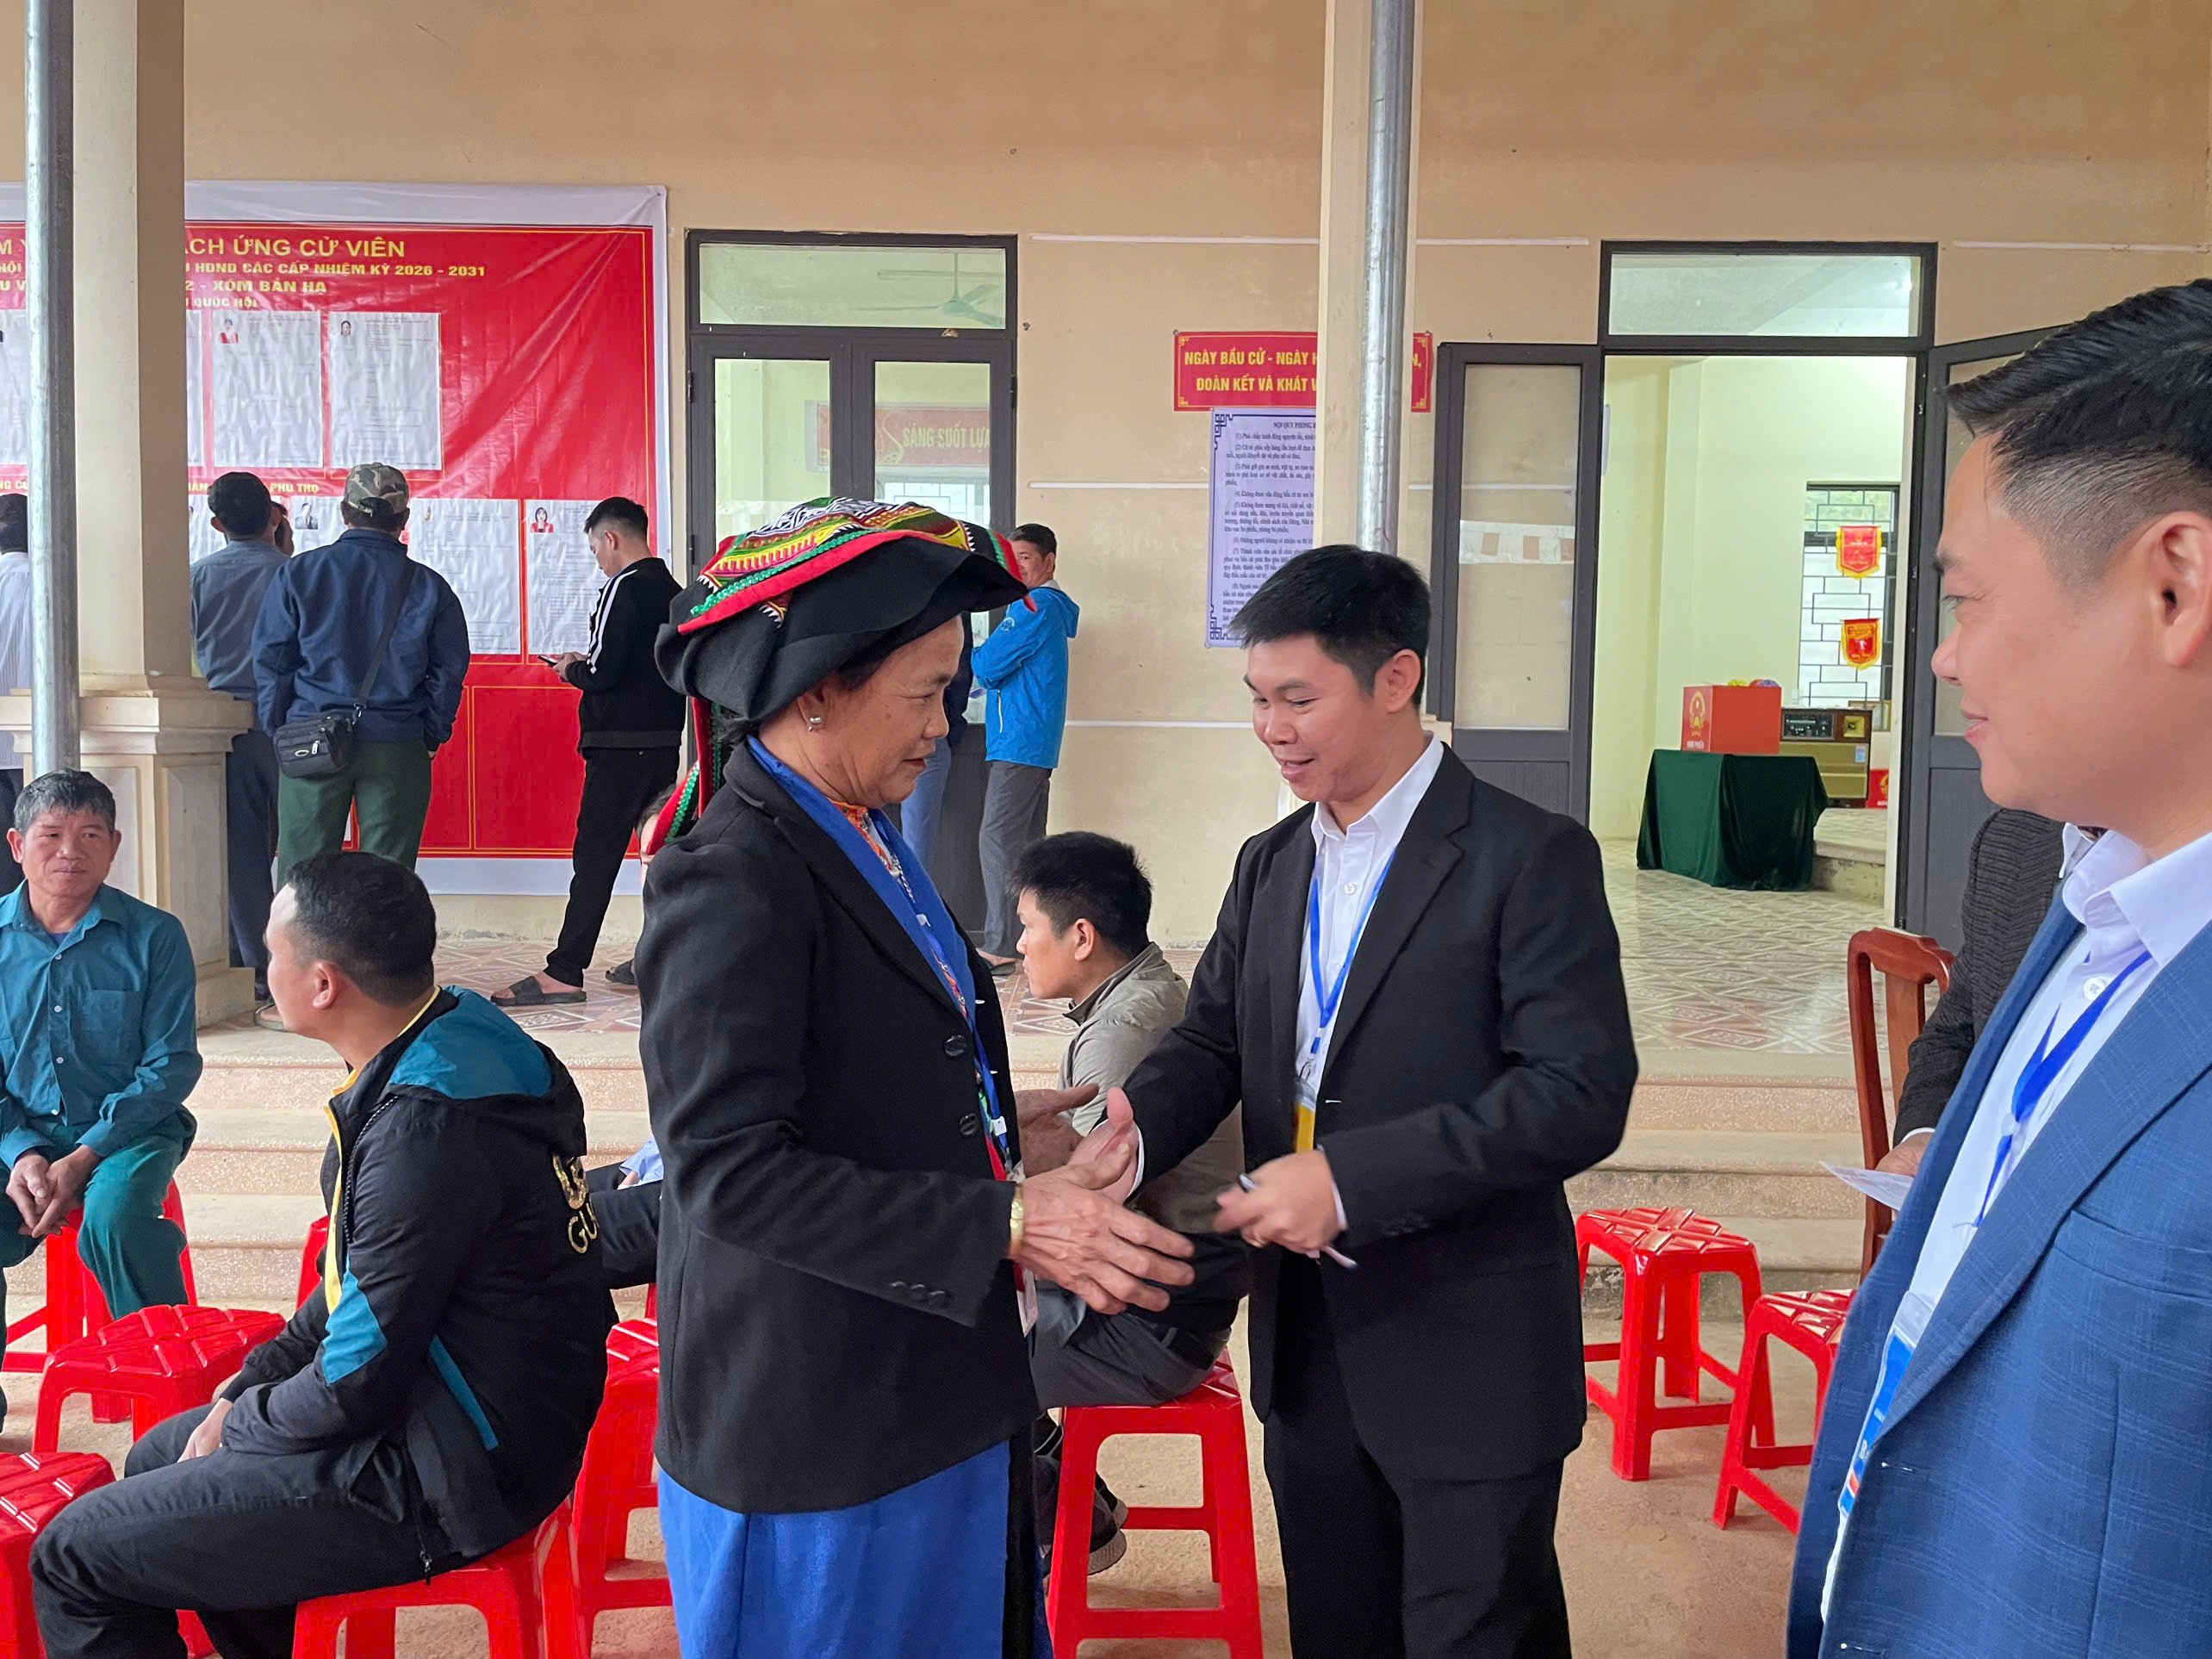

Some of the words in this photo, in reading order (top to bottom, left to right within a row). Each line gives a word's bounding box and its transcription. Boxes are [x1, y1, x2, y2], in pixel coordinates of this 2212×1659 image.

[233, 234, 291, 256] ỨNG
[299, 235, 339, 257] CỬ
[345, 236, 405, 258] VIÊN
[242, 260, 273, 274] CÁC
[277, 259, 309, 274] CẤP
[395, 264, 432, 276] 2026
[448, 265, 485, 276] 2031
[1184, 349, 1217, 365] NGÀY
[1247, 347, 1266, 365] CỬ
[1276, 349, 1308, 365] NGÀY
[1233, 374, 1254, 391] KẾT
[1258, 374, 1274, 391] VÀ
[1277, 375, 1308, 391] KHÁT
[904, 422, 935, 448] SÁNG
[937, 420, 966, 448] SUỐT
